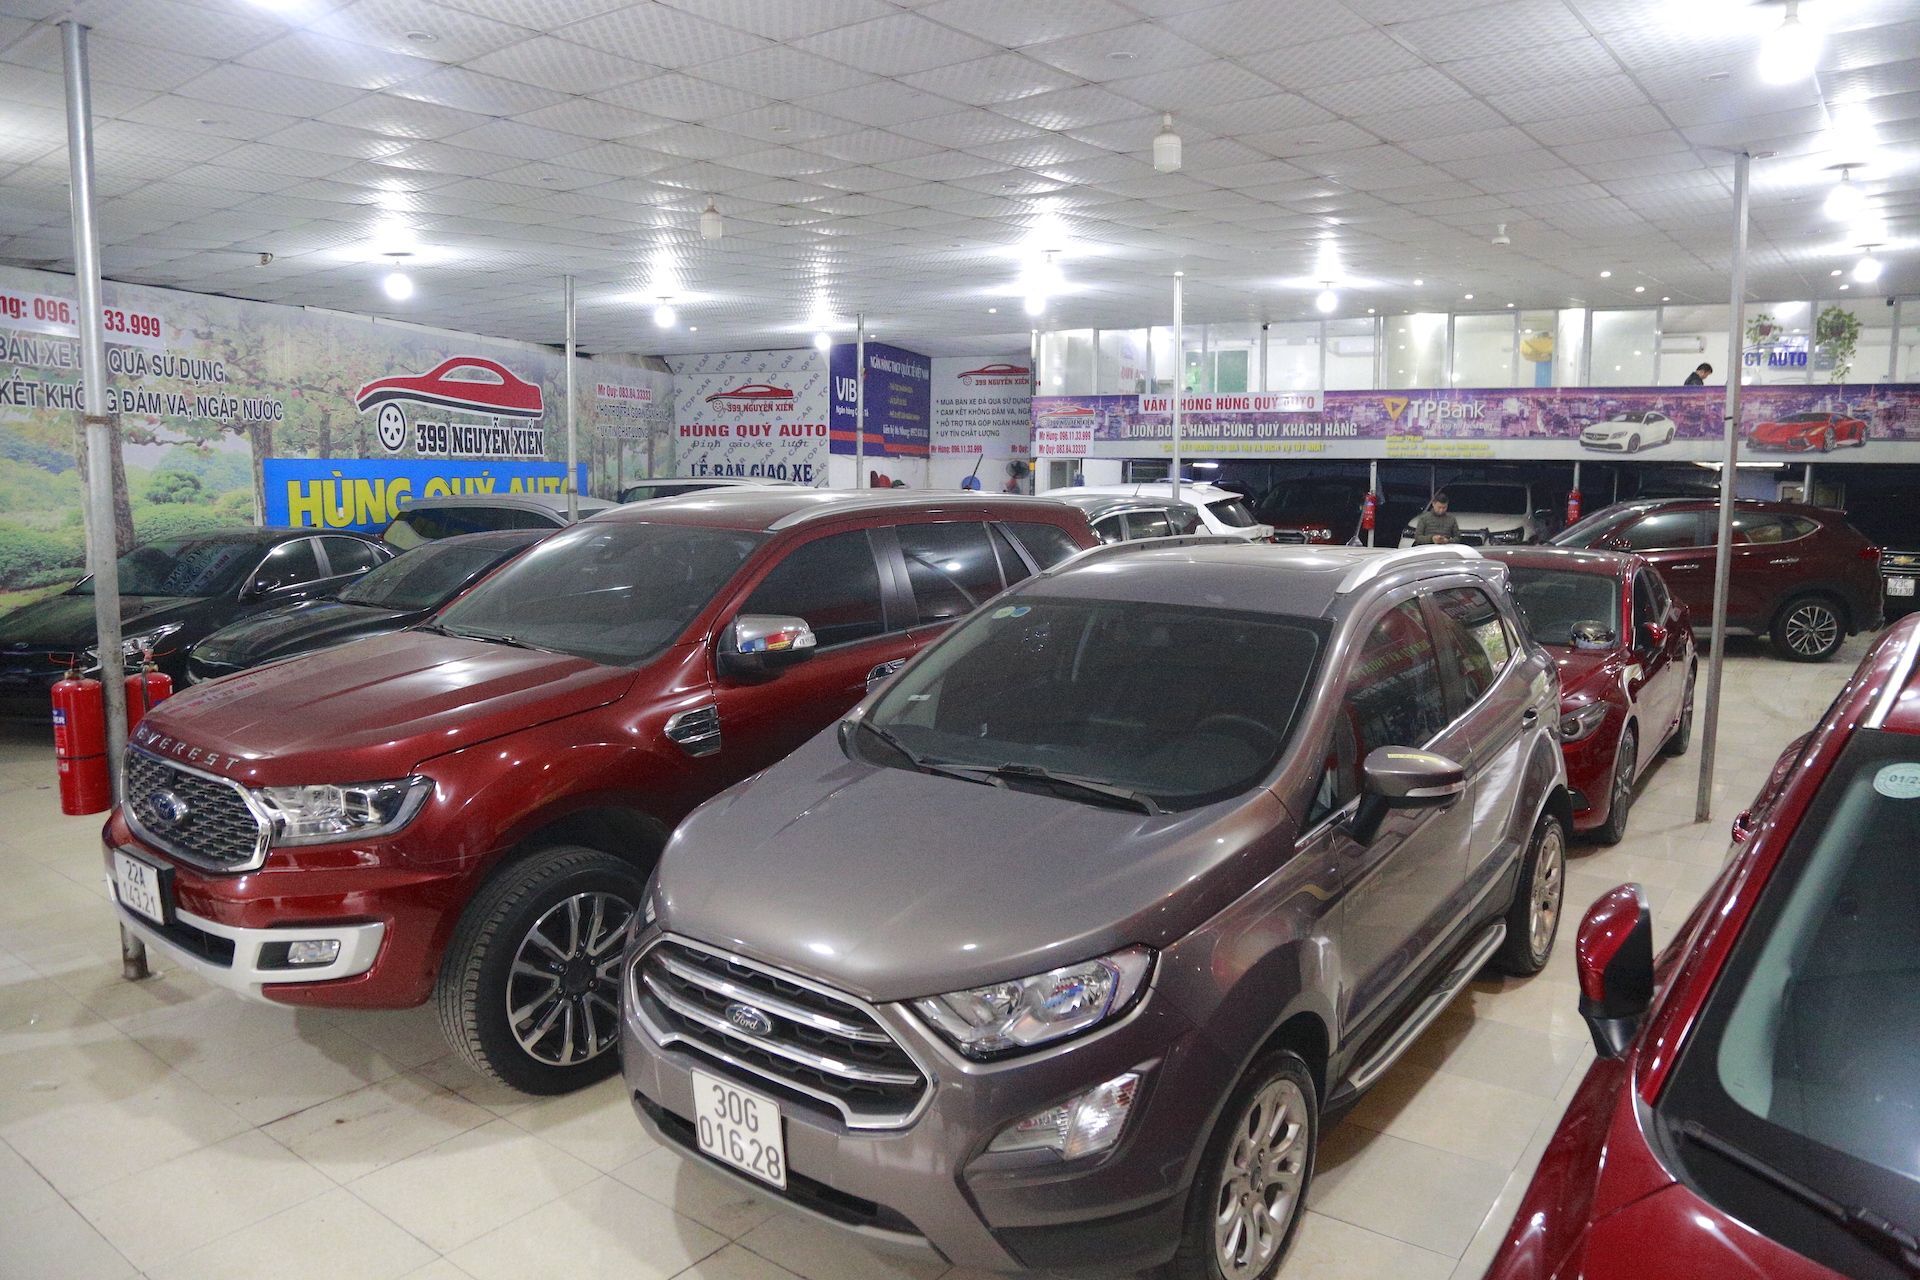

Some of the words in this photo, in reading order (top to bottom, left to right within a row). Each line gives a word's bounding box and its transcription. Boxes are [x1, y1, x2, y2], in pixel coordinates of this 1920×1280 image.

[45, 341, 71, 368] XE
[109, 350, 147, 374] QUA
[180, 357, 225, 385] DỤNG
[1768, 352, 1807, 367] AUTO
[46, 379, 118, 411] KHÔG
[123, 386, 161, 414] ĐÂM
[197, 392, 238, 424] NGẬP
[243, 394, 283, 421] NƯỚC
[836, 376, 857, 402] VIB
[1144, 397, 1166, 411] VĂN
[1216, 394, 1249, 410] HÙNG
[1411, 400, 1485, 418] TPBank
[417, 424, 447, 452] 399
[452, 416, 510, 455] NGUYỄN
[680, 422, 730, 437] HÙNG
[779, 424, 827, 437] AUTO
[1060, 431, 1090, 441] 096.11.33.999
[1190, 421, 1220, 437] HÀNH
[1223, 421, 1254, 437] CÙNG
[1325, 421, 1357, 436] HÀNG
[792, 464, 813, 482] XE
[287, 471, 411, 528] HÙNG
[136, 727, 241, 770] EVEREST
[125, 860, 145, 886] 22A
[732, 1011, 758, 1030] Ford
[712, 1084, 759, 1133] 30G
[699, 1115, 781, 1180] 016.28
